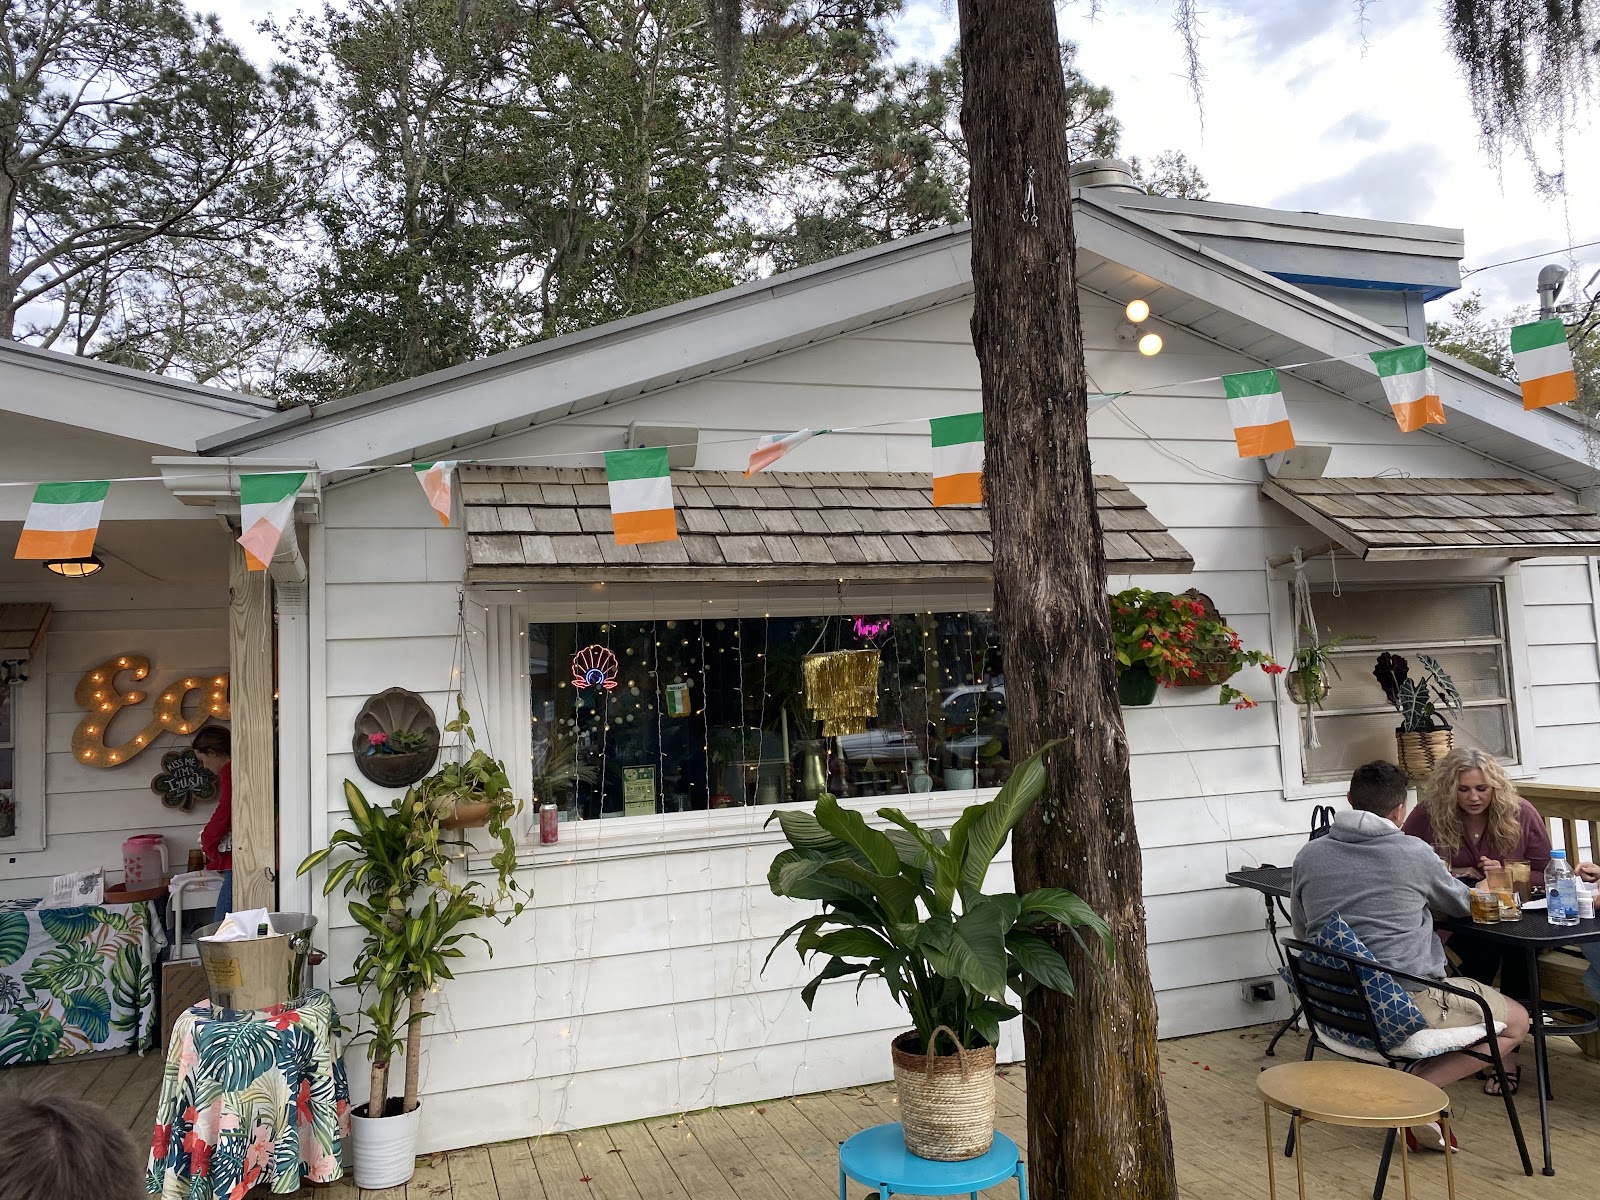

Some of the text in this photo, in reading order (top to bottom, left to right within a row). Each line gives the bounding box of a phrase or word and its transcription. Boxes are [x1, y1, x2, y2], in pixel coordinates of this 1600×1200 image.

[71, 655, 231, 768] Ea
[167, 757, 196, 771] KISS ME
[164, 773, 203, 792] Irish
